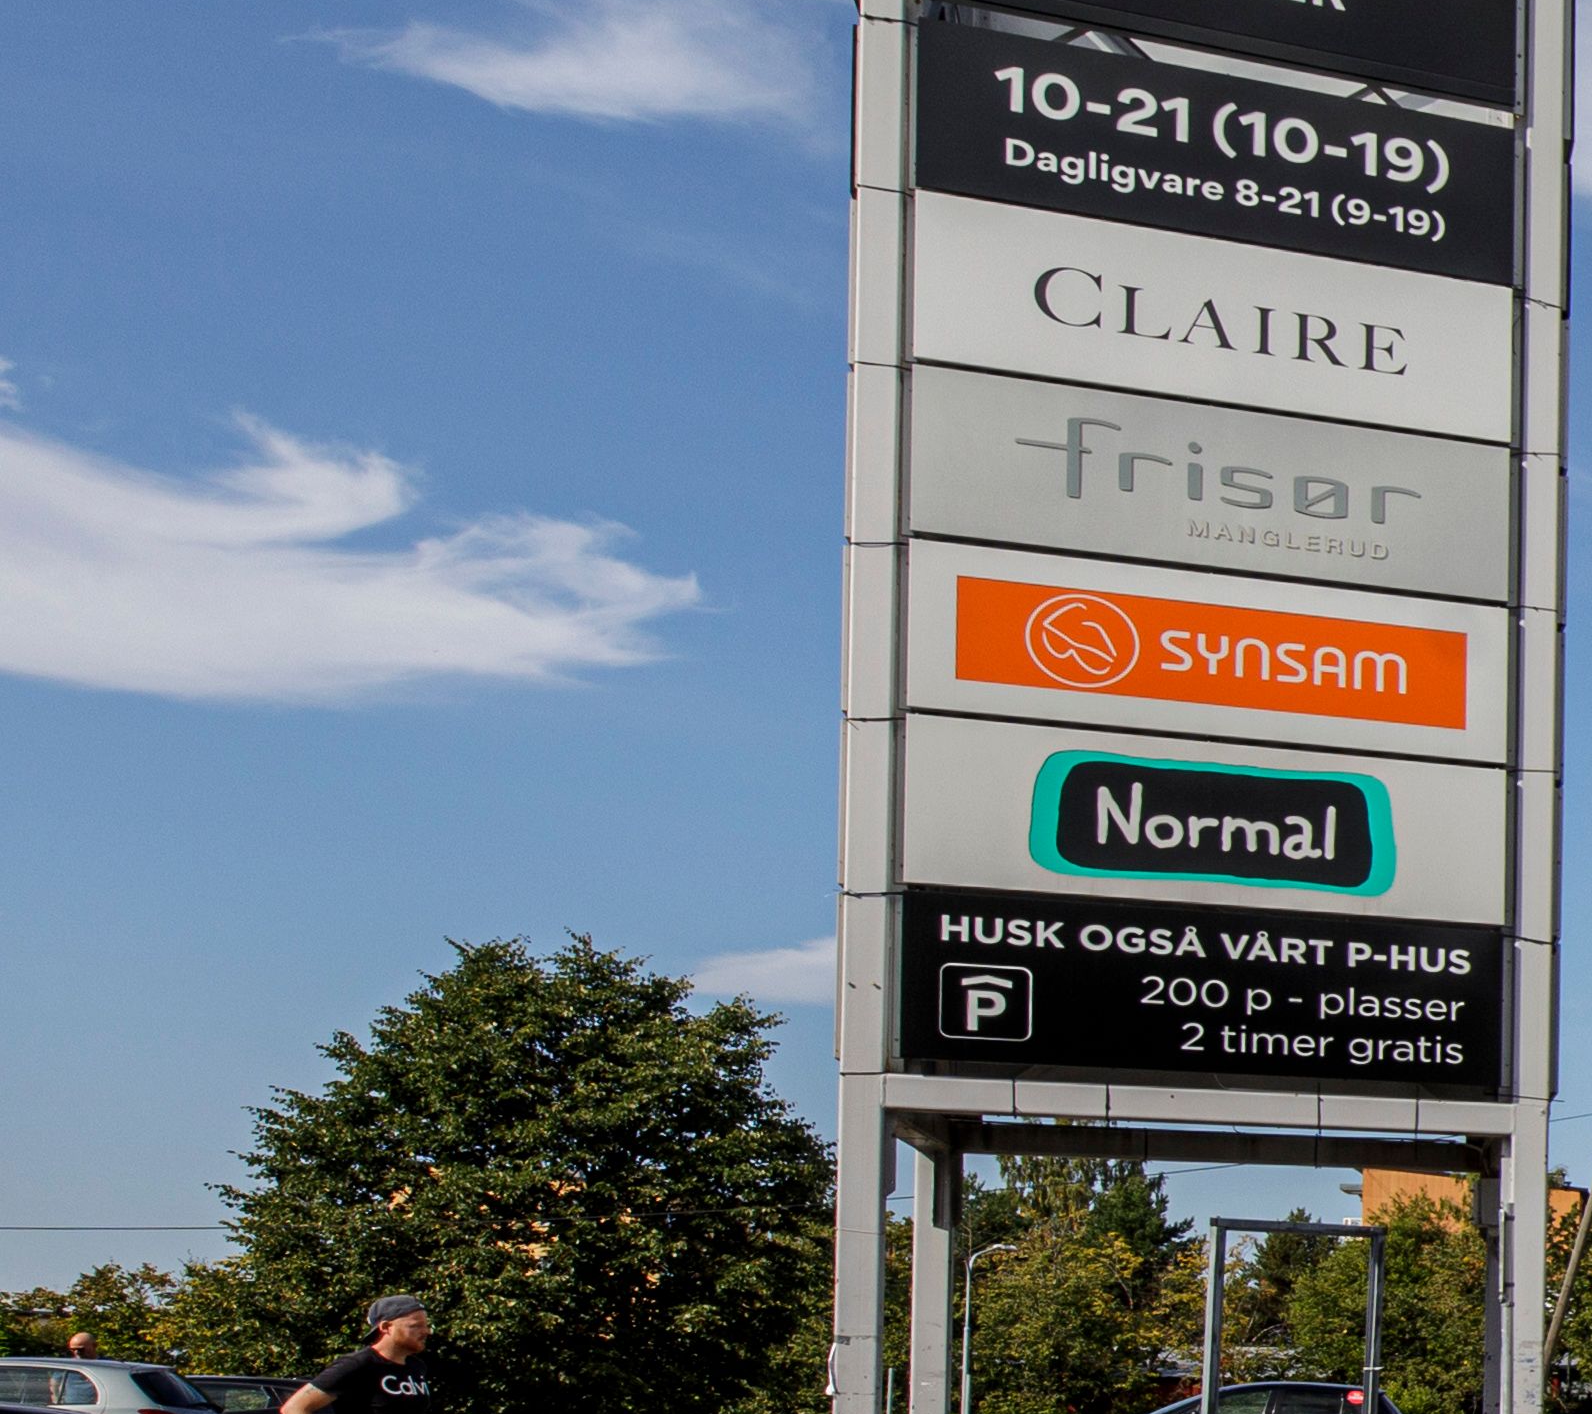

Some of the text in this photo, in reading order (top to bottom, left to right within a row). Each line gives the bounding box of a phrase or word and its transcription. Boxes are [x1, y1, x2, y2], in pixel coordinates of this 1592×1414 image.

[994, 65, 1450, 194] 10-21 (10-19)
[1004, 138, 1446, 242] Dagligvare 8-21 (9-19)
[1034, 266, 1408, 375] CLAIRE
[1015, 416, 1421, 524] frisør
[1186, 518, 1389, 560] MANGLERUD
[1160, 629, 1407, 694] SYNSAM
[1097, 782, 1337, 861] Normal
[940, 914, 1471, 976] HUSK OGSÅ VÅRT P-HUS
[966, 989, 1006, 1031] P
[1140, 976, 1229, 1009] 200
[1246, 988, 1272, 1015] p
[1319, 986, 1465, 1023] plasser
[1181, 1022, 1464, 1065] 2 timer gratis
